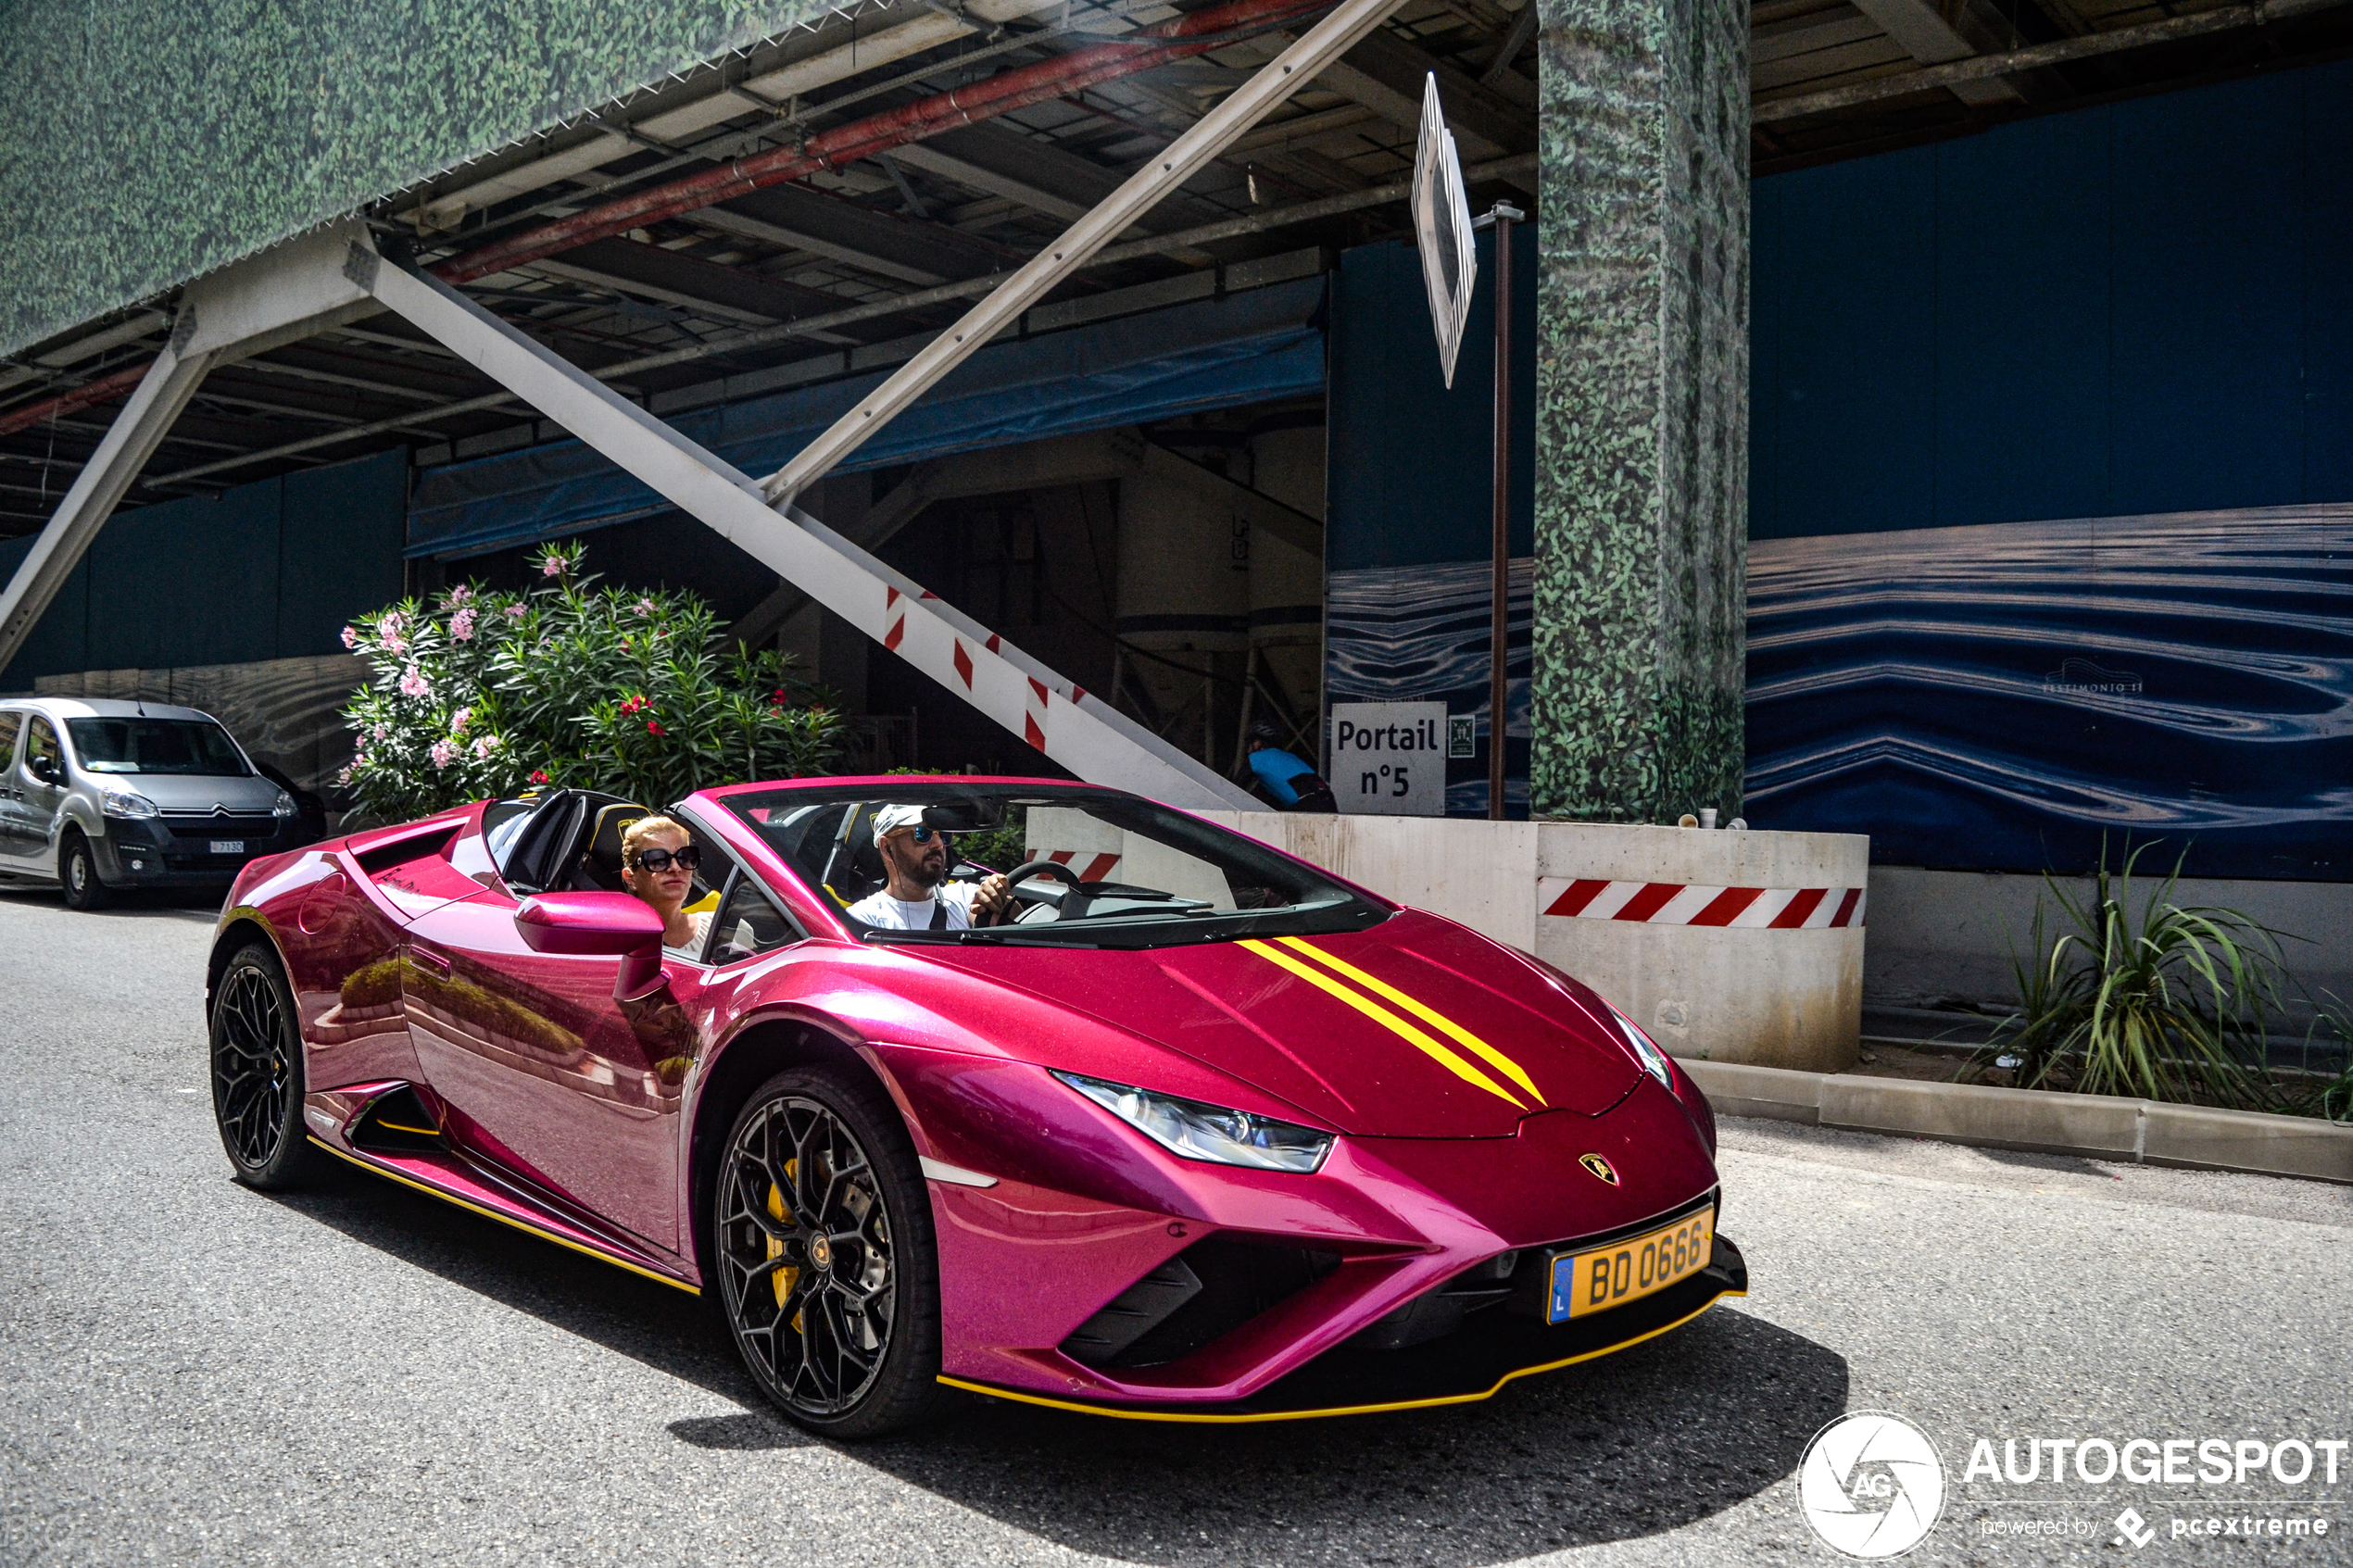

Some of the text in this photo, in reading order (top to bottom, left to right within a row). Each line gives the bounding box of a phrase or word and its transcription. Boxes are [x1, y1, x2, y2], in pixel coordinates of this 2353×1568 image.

[2042, 683, 2125, 693] TESTIMONIO
[1338, 719, 1438, 751] Portail
[1361, 764, 1410, 797] n°5
[1590, 1220, 1703, 1306] BD 0666
[1556, 1296, 1565, 1311] L
